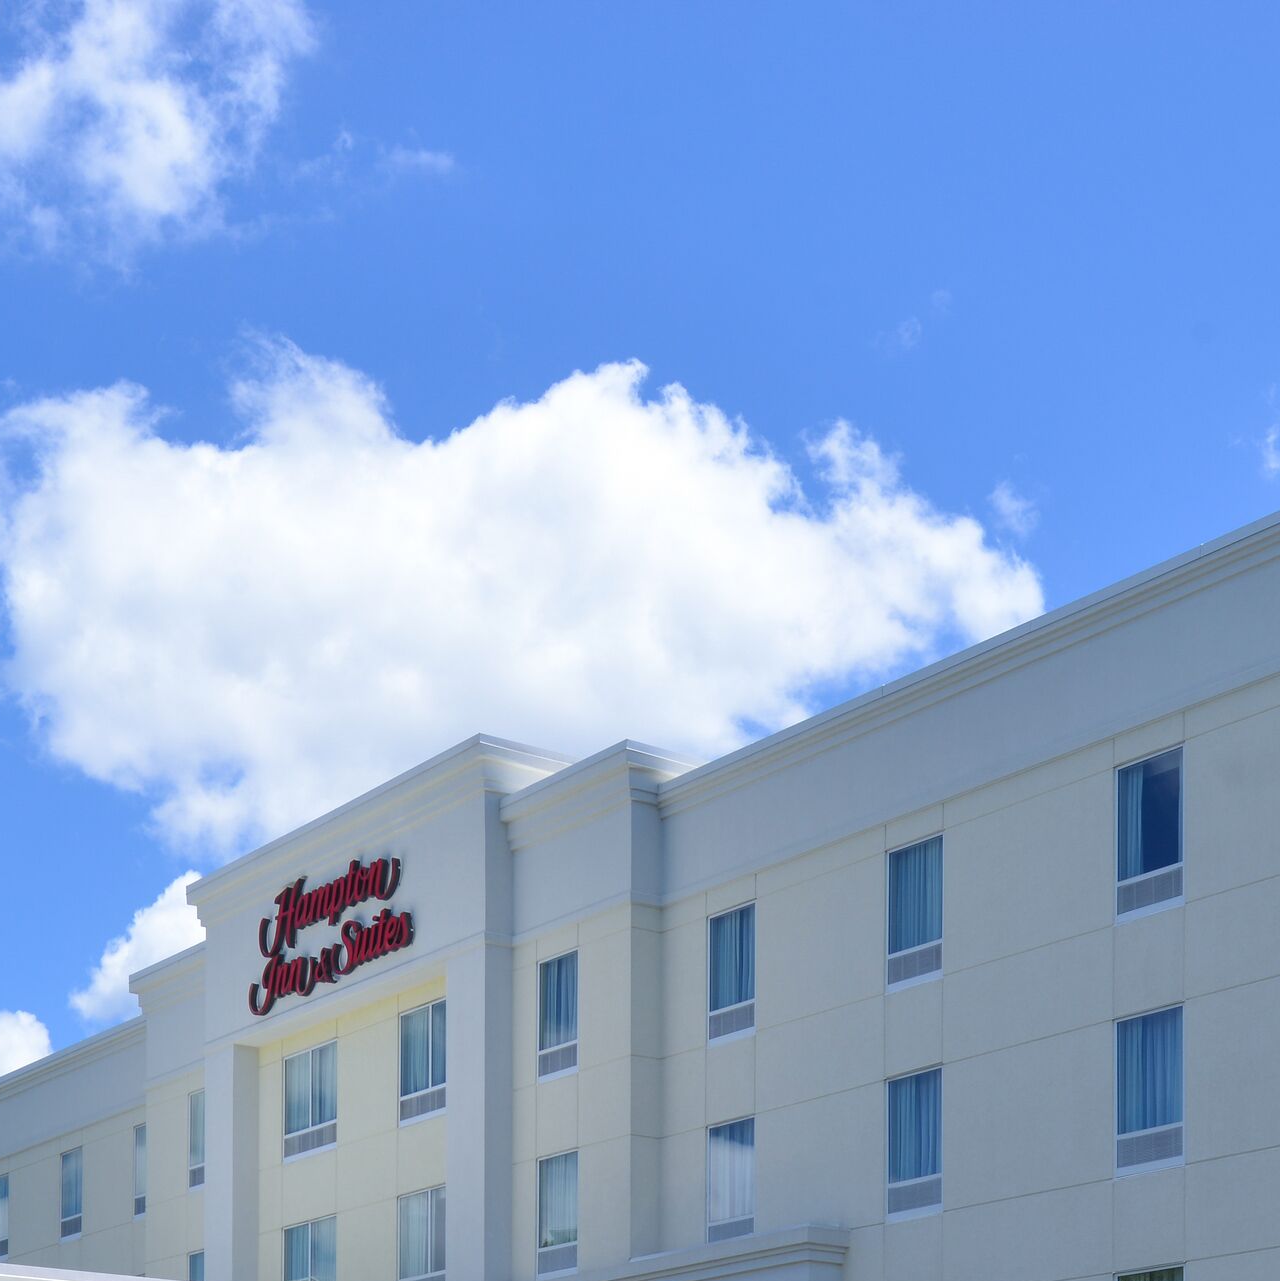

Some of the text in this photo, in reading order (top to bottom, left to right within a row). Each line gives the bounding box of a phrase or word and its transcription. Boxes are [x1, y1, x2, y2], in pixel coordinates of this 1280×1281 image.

[258, 857, 402, 958] Hampton
[249, 908, 415, 1016] Inn & Suites
